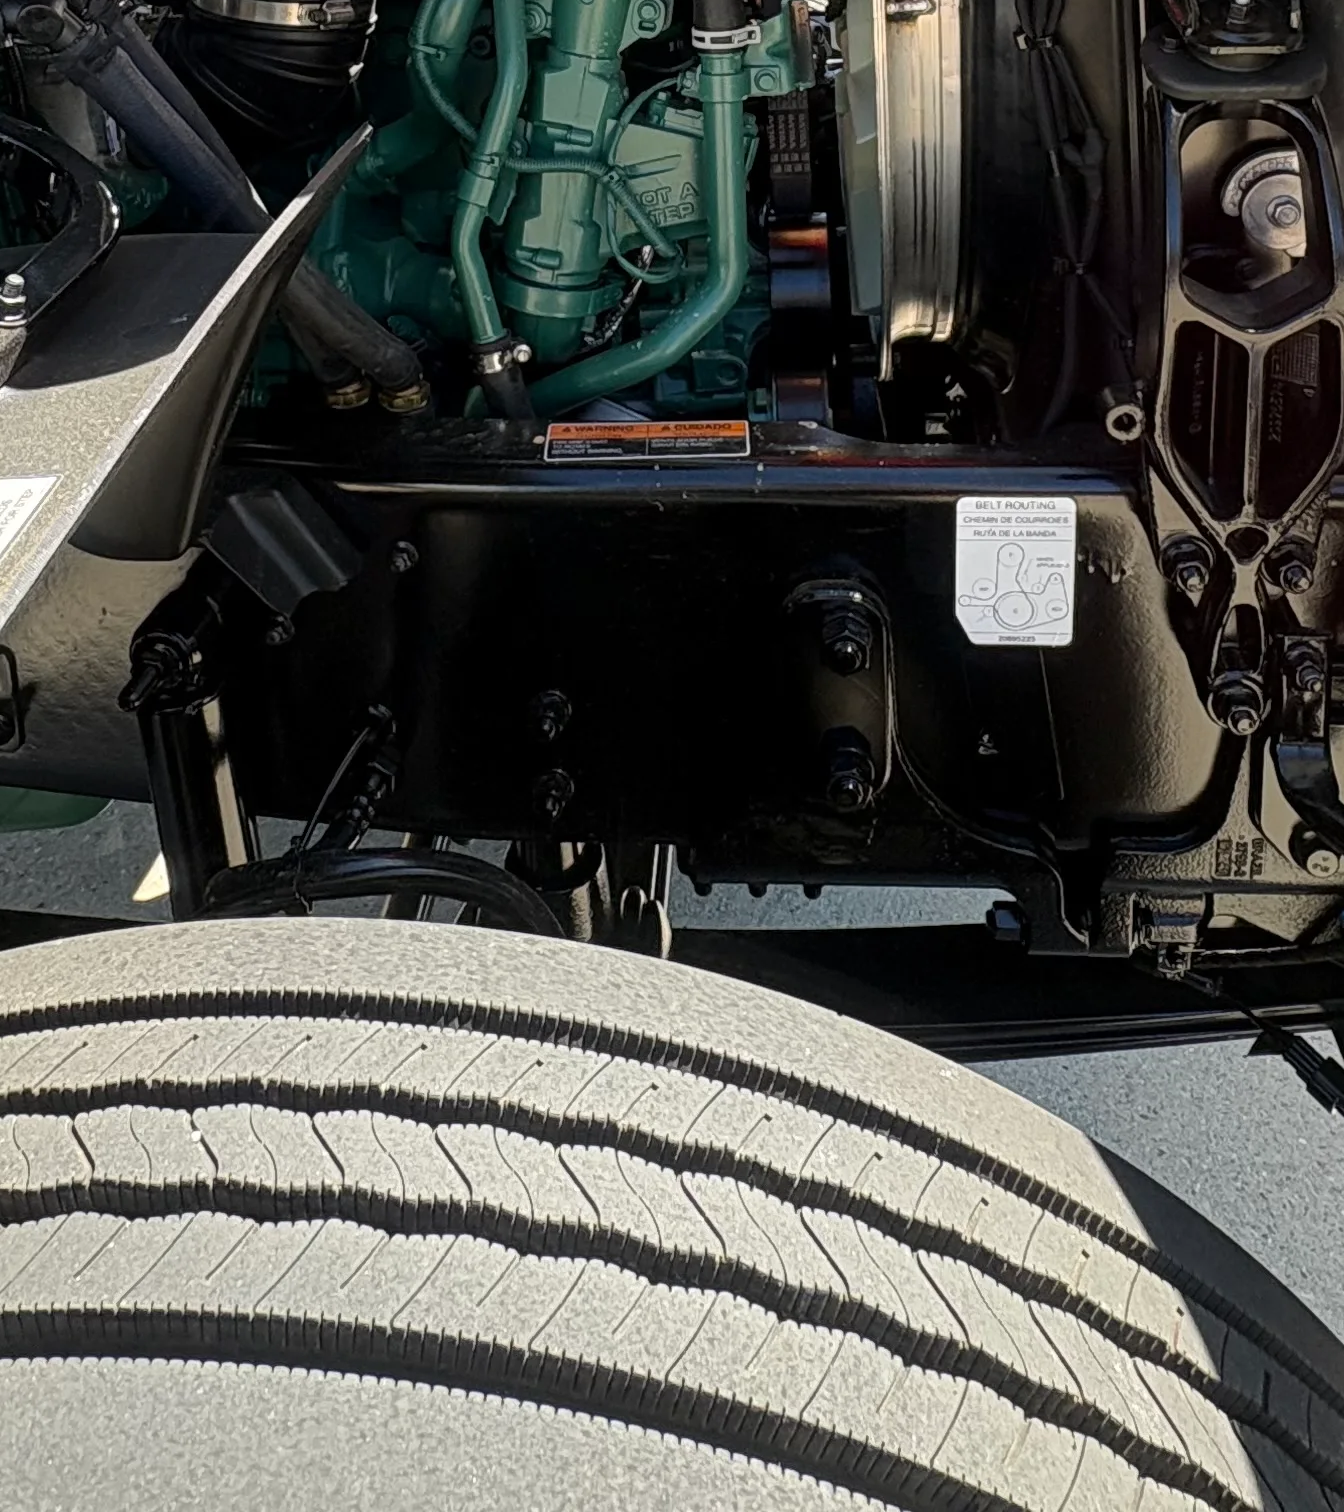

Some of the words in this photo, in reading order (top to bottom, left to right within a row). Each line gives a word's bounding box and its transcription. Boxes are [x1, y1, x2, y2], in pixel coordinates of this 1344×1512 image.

[975, 501, 1001, 510] BELT
[1004, 500, 1056, 510] ROUTING
[963, 516, 999, 524] CHEMIN
[1001, 516, 1013, 524] DE
[999, 529, 1010, 537] DE
